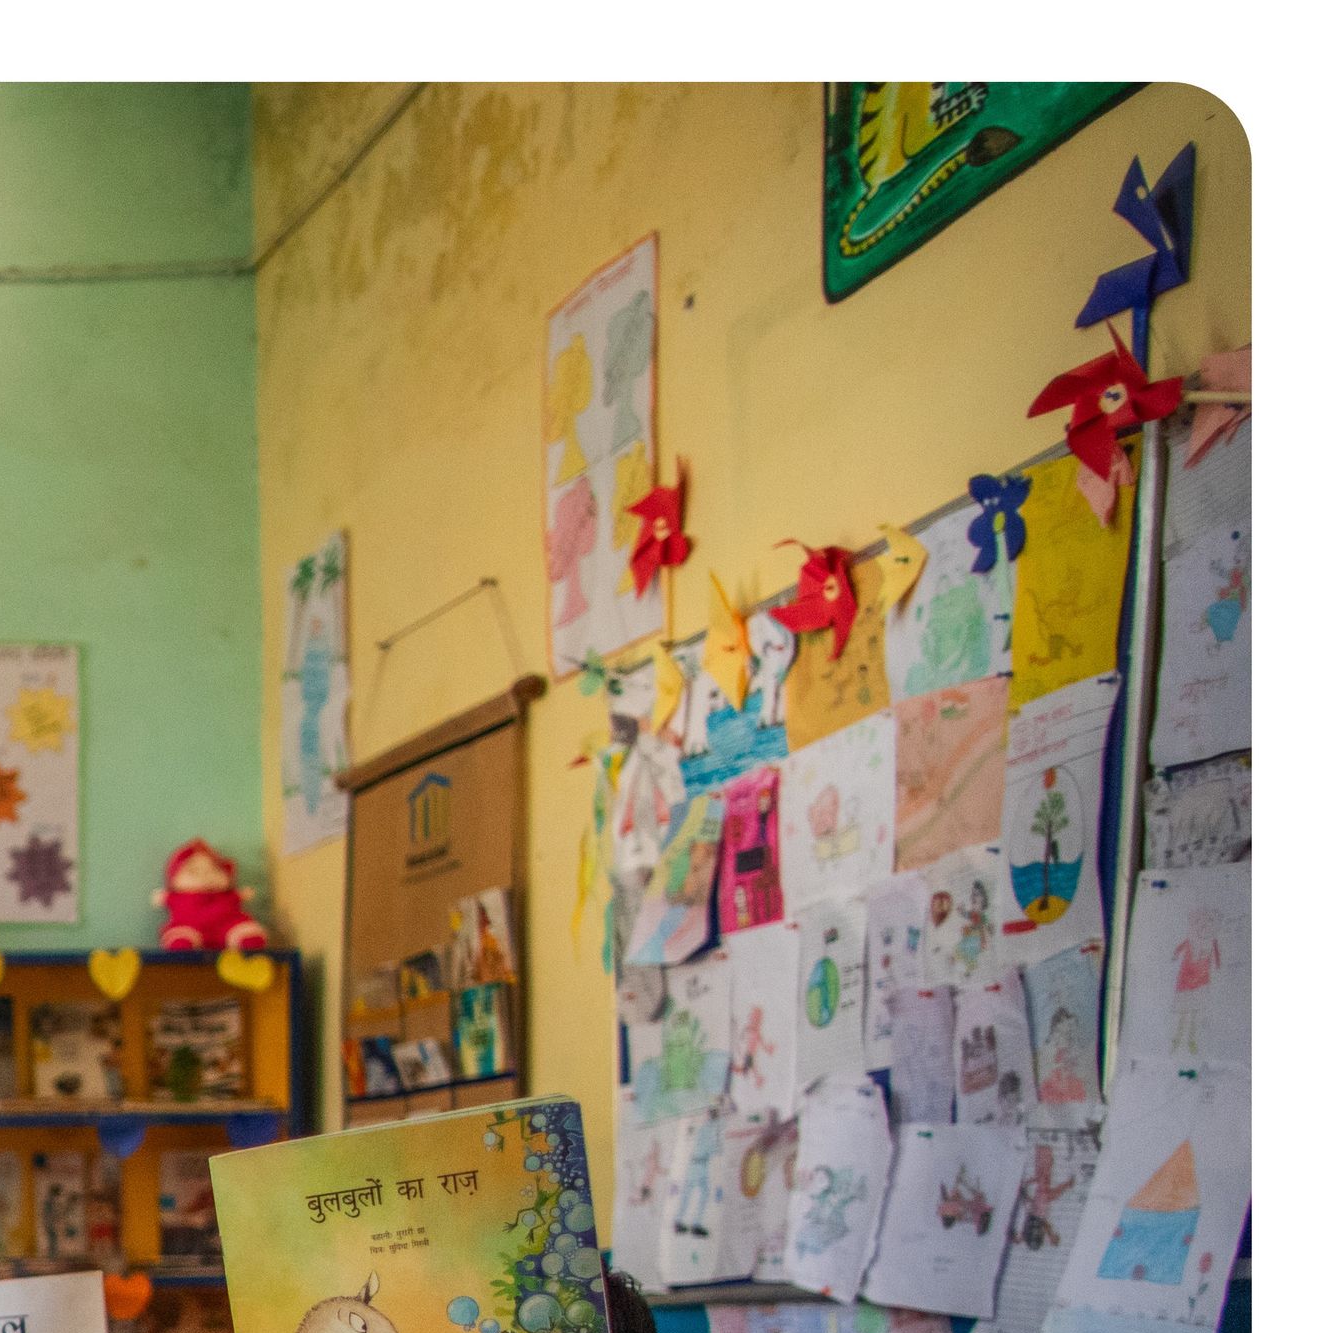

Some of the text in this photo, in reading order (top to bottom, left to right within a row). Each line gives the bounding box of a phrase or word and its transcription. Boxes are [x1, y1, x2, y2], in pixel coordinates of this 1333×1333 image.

[306, 1170, 479, 1224] बुलबुलों का राज़
